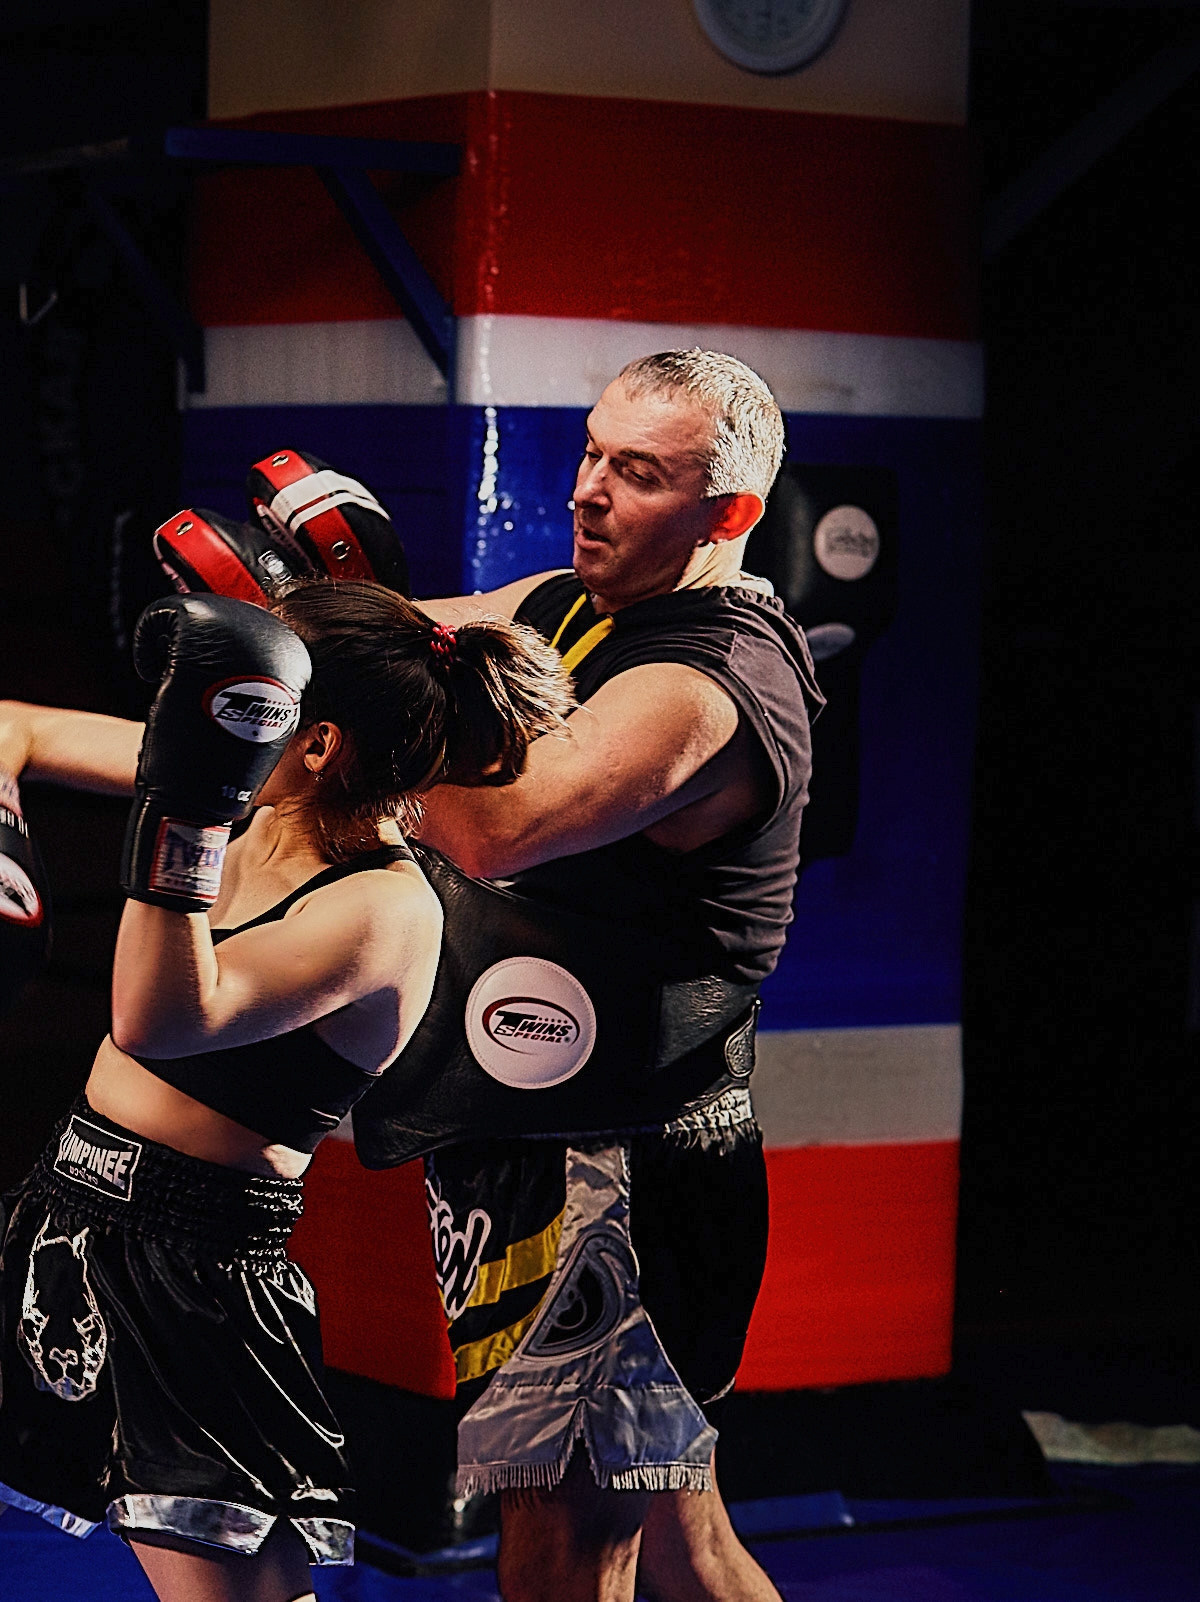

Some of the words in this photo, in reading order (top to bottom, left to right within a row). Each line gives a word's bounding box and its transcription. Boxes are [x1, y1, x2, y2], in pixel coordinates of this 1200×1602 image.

[215, 691, 292, 723] TWINS
[494, 1010, 573, 1037] TWINS
[495, 1023, 563, 1044] SPECIAL
